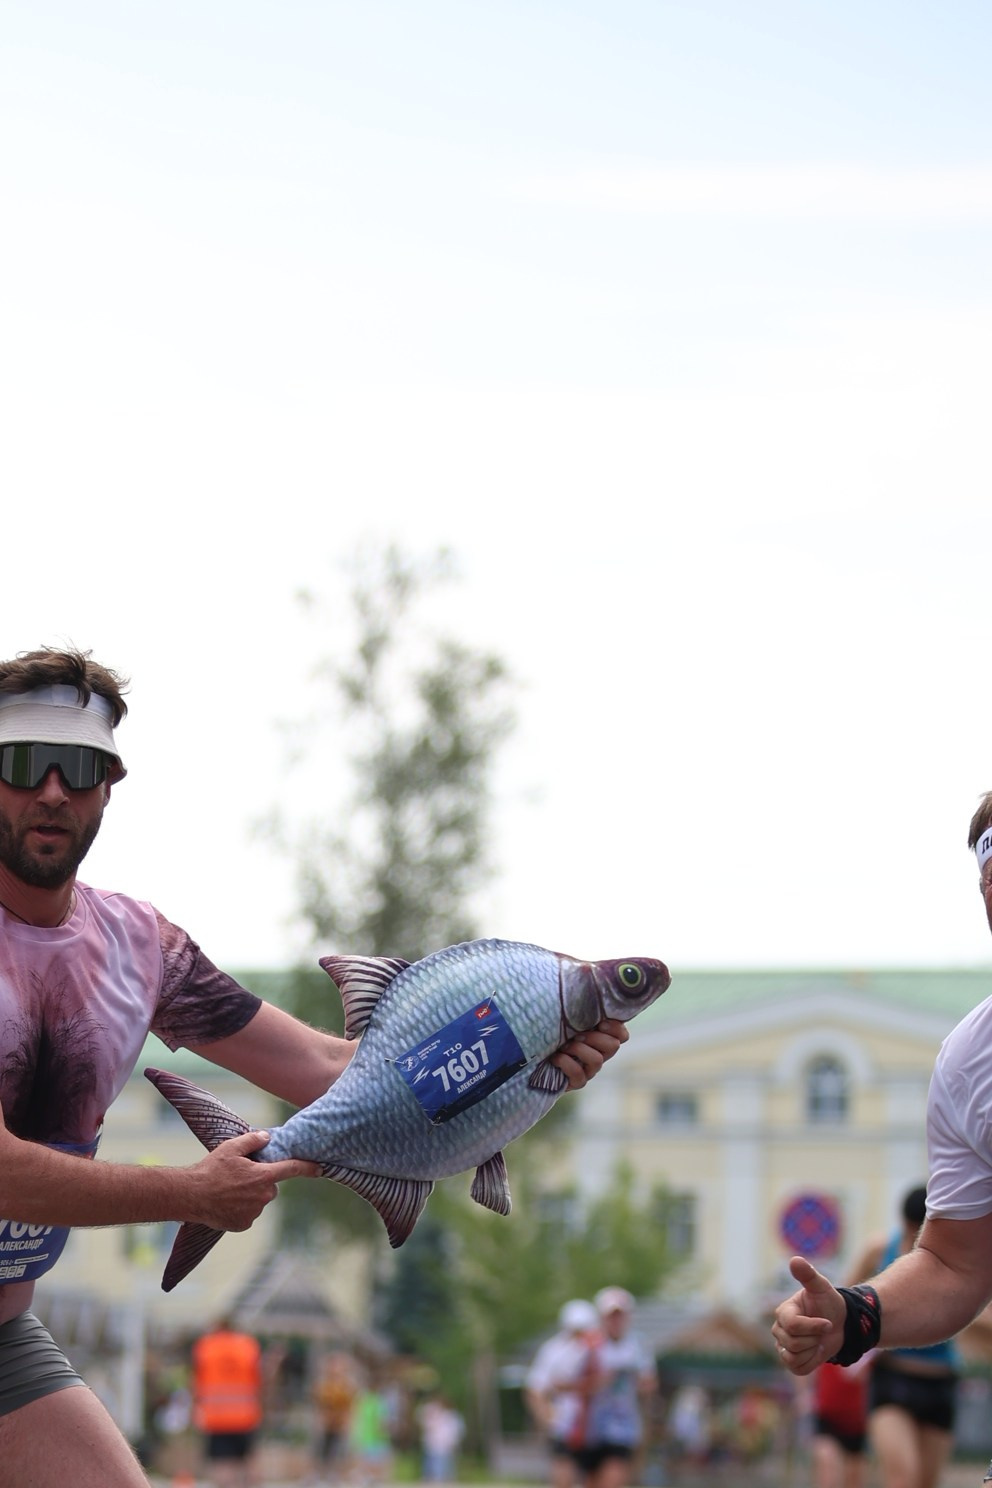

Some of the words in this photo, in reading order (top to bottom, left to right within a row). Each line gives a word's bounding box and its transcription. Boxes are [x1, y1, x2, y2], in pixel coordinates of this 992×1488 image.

[443, 1043, 462, 1057] T10
[432, 1039, 489, 1092] 7607
[457, 1069, 487, 1093] АЛЕКСАНДР
